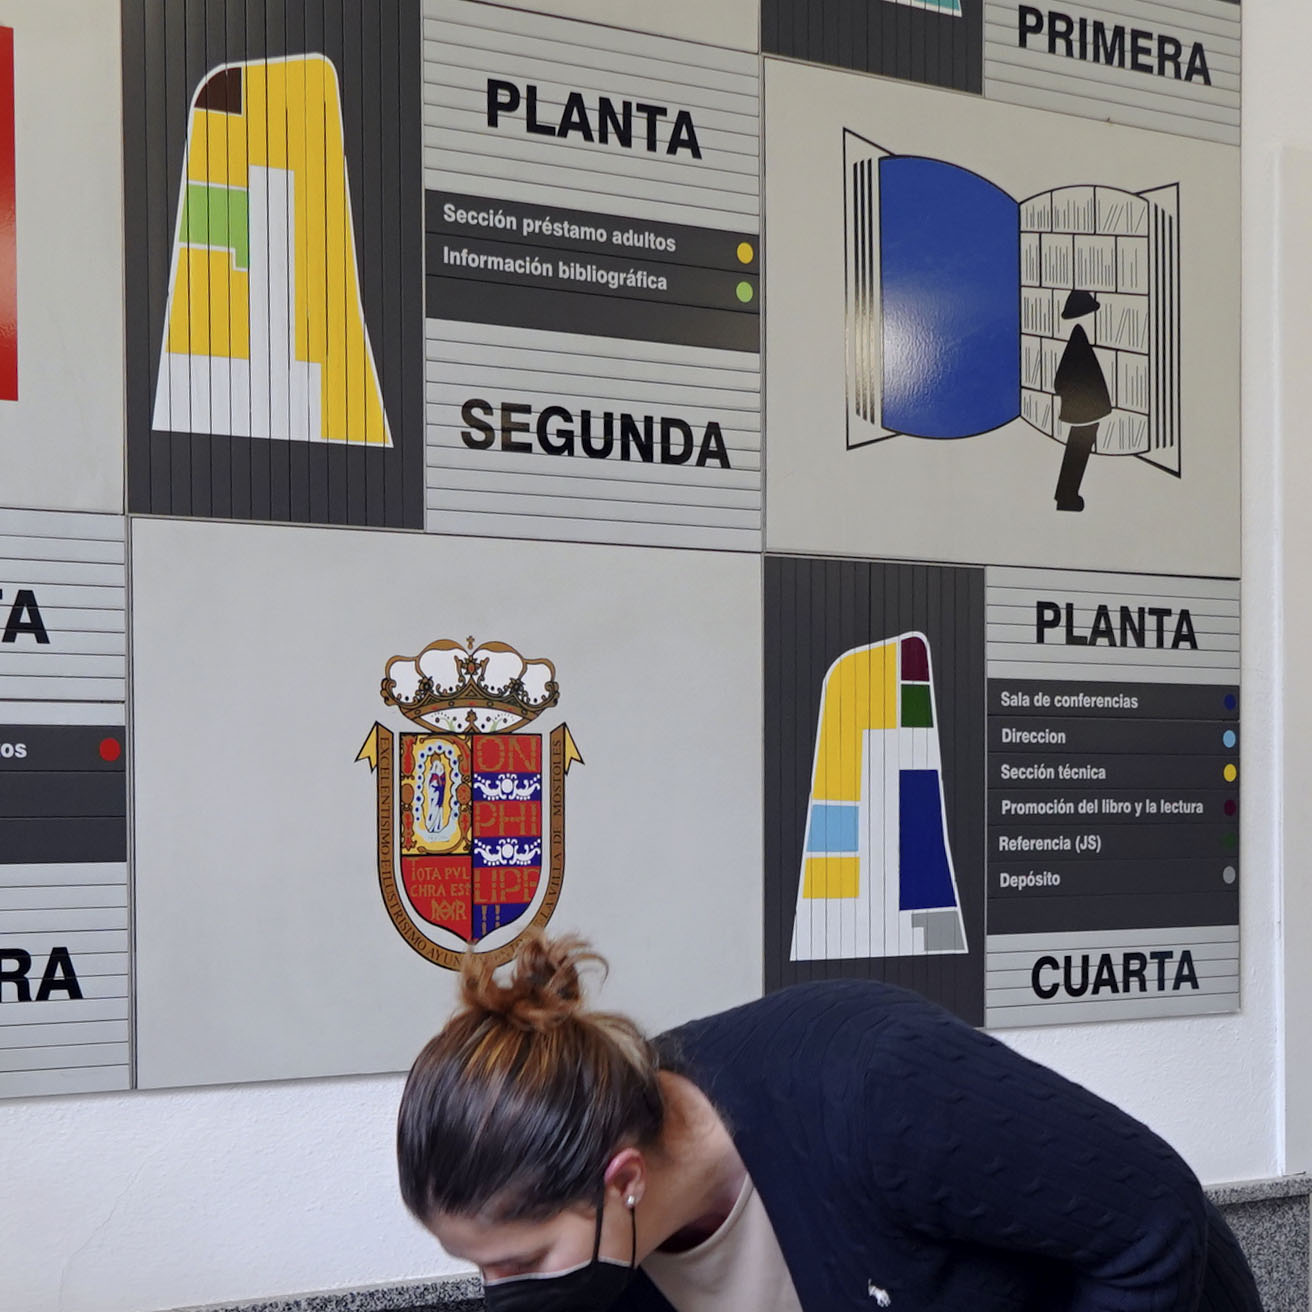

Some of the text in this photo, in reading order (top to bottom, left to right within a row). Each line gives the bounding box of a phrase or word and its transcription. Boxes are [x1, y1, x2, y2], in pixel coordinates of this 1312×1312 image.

[1017, 4, 1212, 86] PRIMERA
[487, 78, 703, 160] PLANTA
[443, 203, 676, 252] Sección préstamo adultos
[443, 246, 668, 291] Información bibliográfica
[460, 398, 732, 469] SEGUNDA
[1036, 600, 1198, 650] PLANTA
[1000, 692, 1139, 709] Sala de conferencias
[1001, 728, 1066, 745] Direccion
[1000, 763, 1106, 780] Sección técnica
[1001, 798, 1204, 817] Promoción del libro y la lectura
[998, 835, 1102, 853] Referencia (JS)
[999, 871, 1061, 891] Depósito
[1031, 949, 1200, 1000] CUARTA
